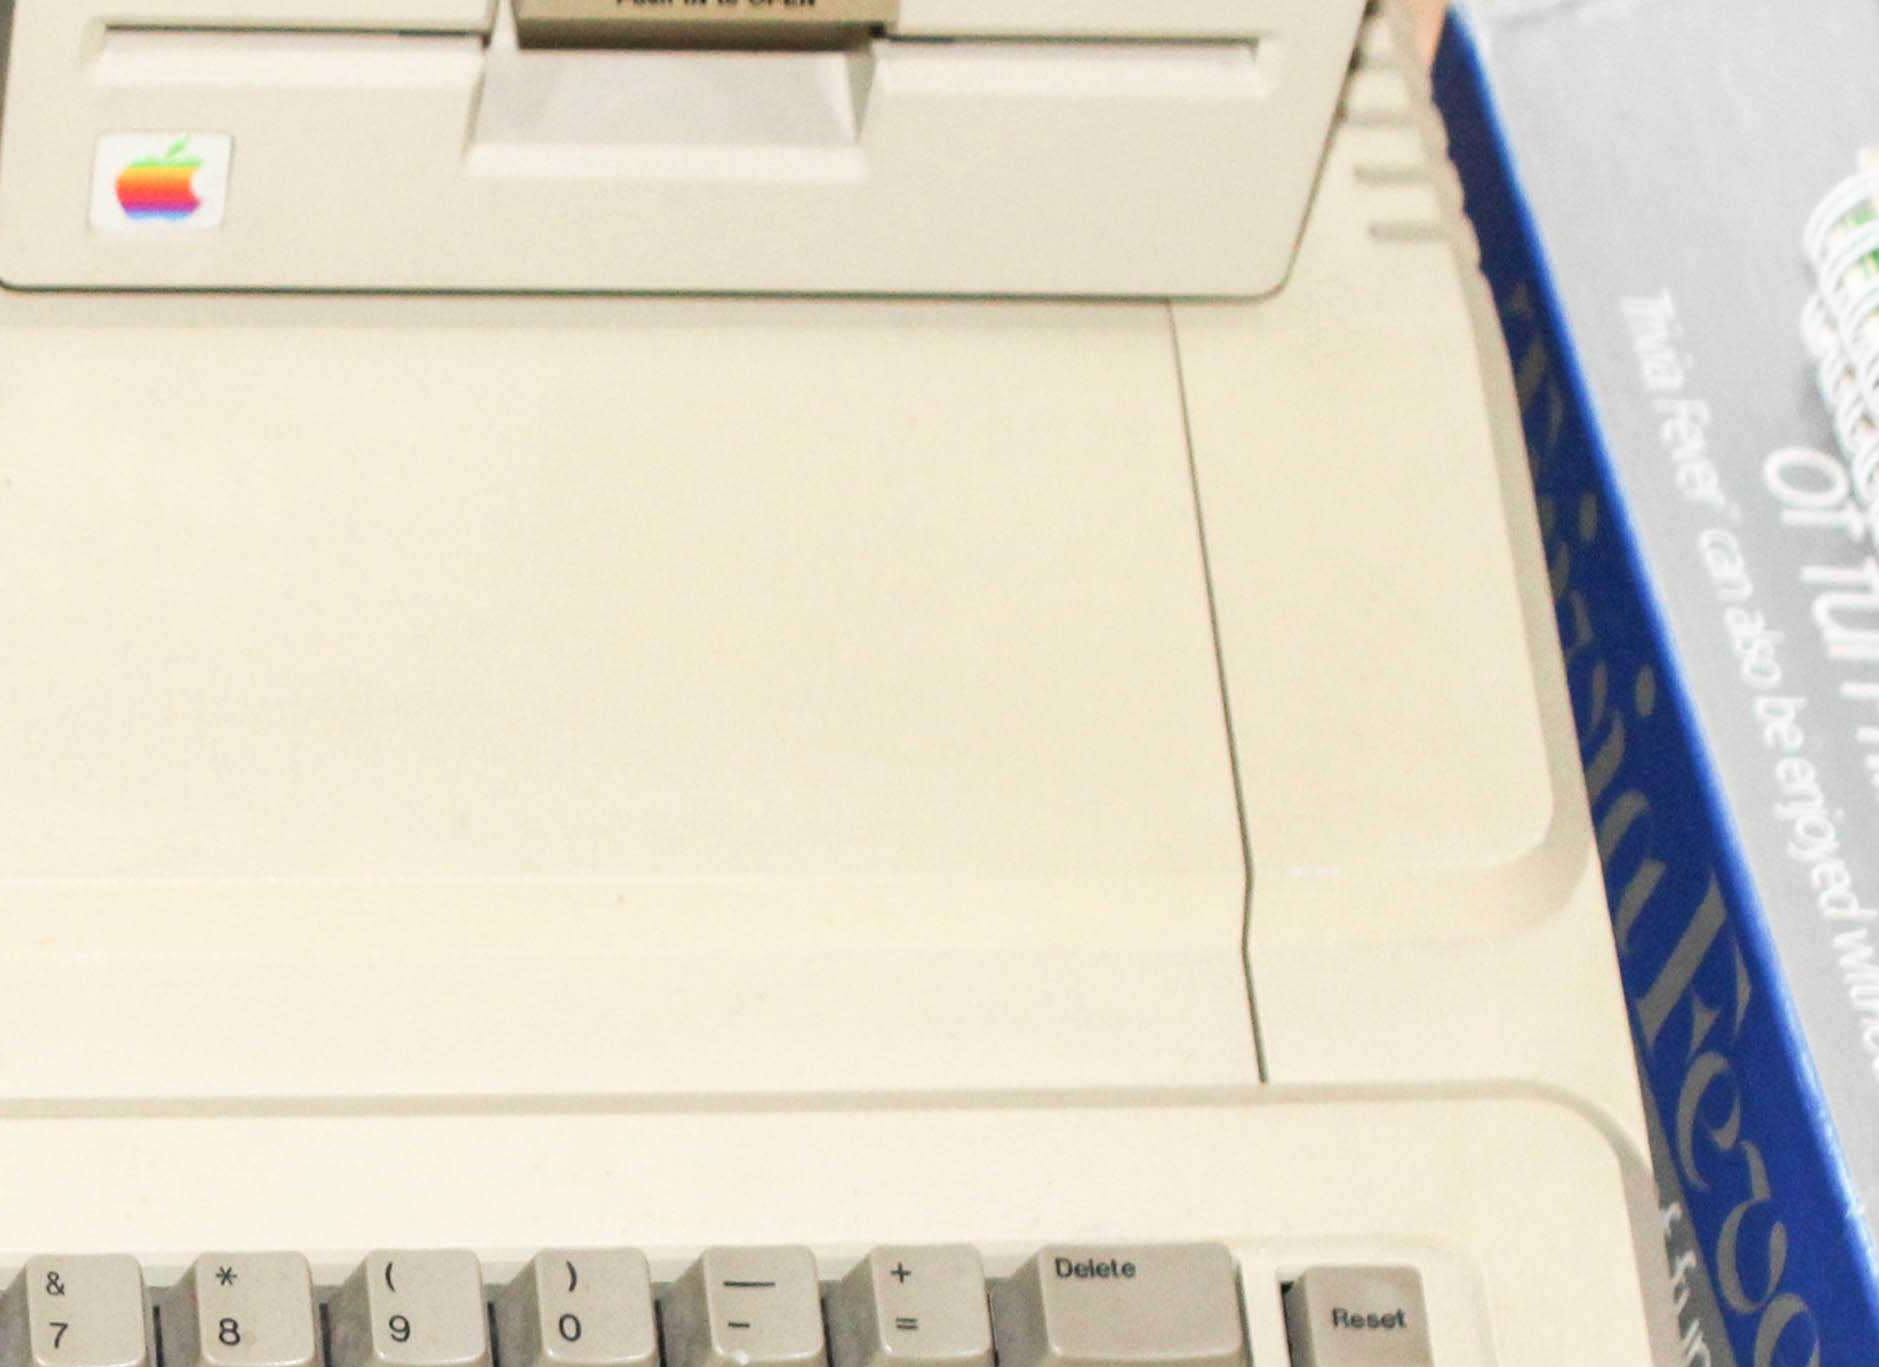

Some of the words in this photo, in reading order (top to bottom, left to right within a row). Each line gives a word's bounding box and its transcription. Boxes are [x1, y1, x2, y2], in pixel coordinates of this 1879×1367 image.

[1621, 288, 1695, 392] Trivia
[1697, 527, 1754, 602] can
[1724, 606, 1785, 690] also
[1755, 694, 1808, 751] be
[1773, 756, 1878, 920] enjoyed
[45, 1270, 65, 1296] &
[384, 1262, 395, 1292] (
[566, 1261, 578, 1293] )
[890, 1263, 912, 1284] +
[1054, 1257, 1136, 1279] Delete
[218, 1317, 241, 1347] 8
[388, 1314, 411, 1343] 9
[558, 1313, 582, 1343] 0
[895, 1317, 919, 1331] =
[1331, 1307, 1407, 1330] Reset
[49, 1322, 69, 1349] 7
